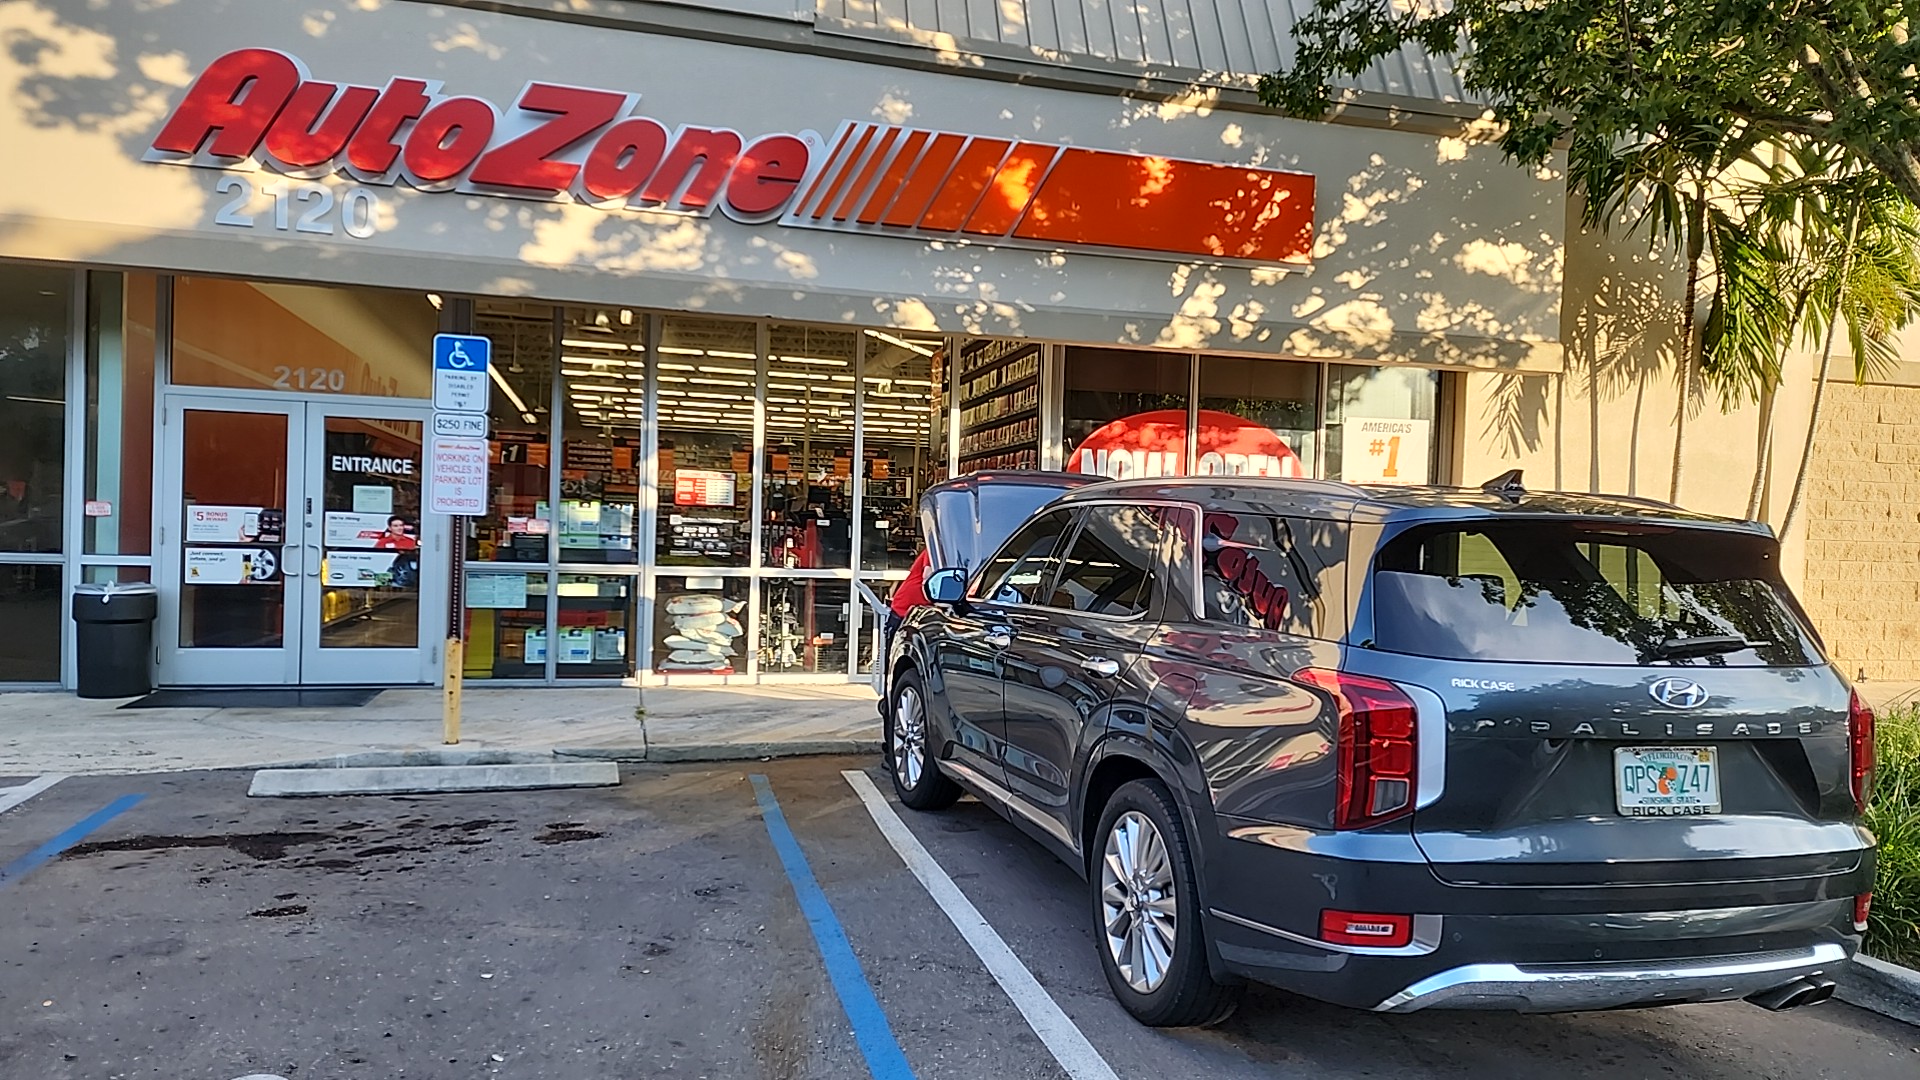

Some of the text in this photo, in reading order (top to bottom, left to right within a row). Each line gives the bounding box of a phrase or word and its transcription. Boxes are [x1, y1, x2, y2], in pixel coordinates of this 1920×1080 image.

[149, 47, 812, 216] AutoZone
[214, 175, 380, 238] 2120
[272, 366, 345, 392] 2120
[437, 419, 482, 430] $250 FINE
[1361, 421, 1412, 434] AMERICA'S
[436, 453, 483, 463] WORKING ON
[1369, 436, 1401, 477] #1
[332, 455, 413, 475] ENTRANCE
[437, 464, 482, 475] VEHICLES IN
[435, 475, 482, 485] PARKING LOT
[455, 487, 462, 496] IS
[436, 497, 479, 507] PROHIBITED
[1452, 678, 1515, 691] RICK CASE
[1530, 721, 1813, 736] PALISADE
[1624, 765, 1710, 793] QPS Z47
[1642, 796, 1697, 805] SUNSHINE STATE
[1632, 805, 1711, 816] RICK CASE
